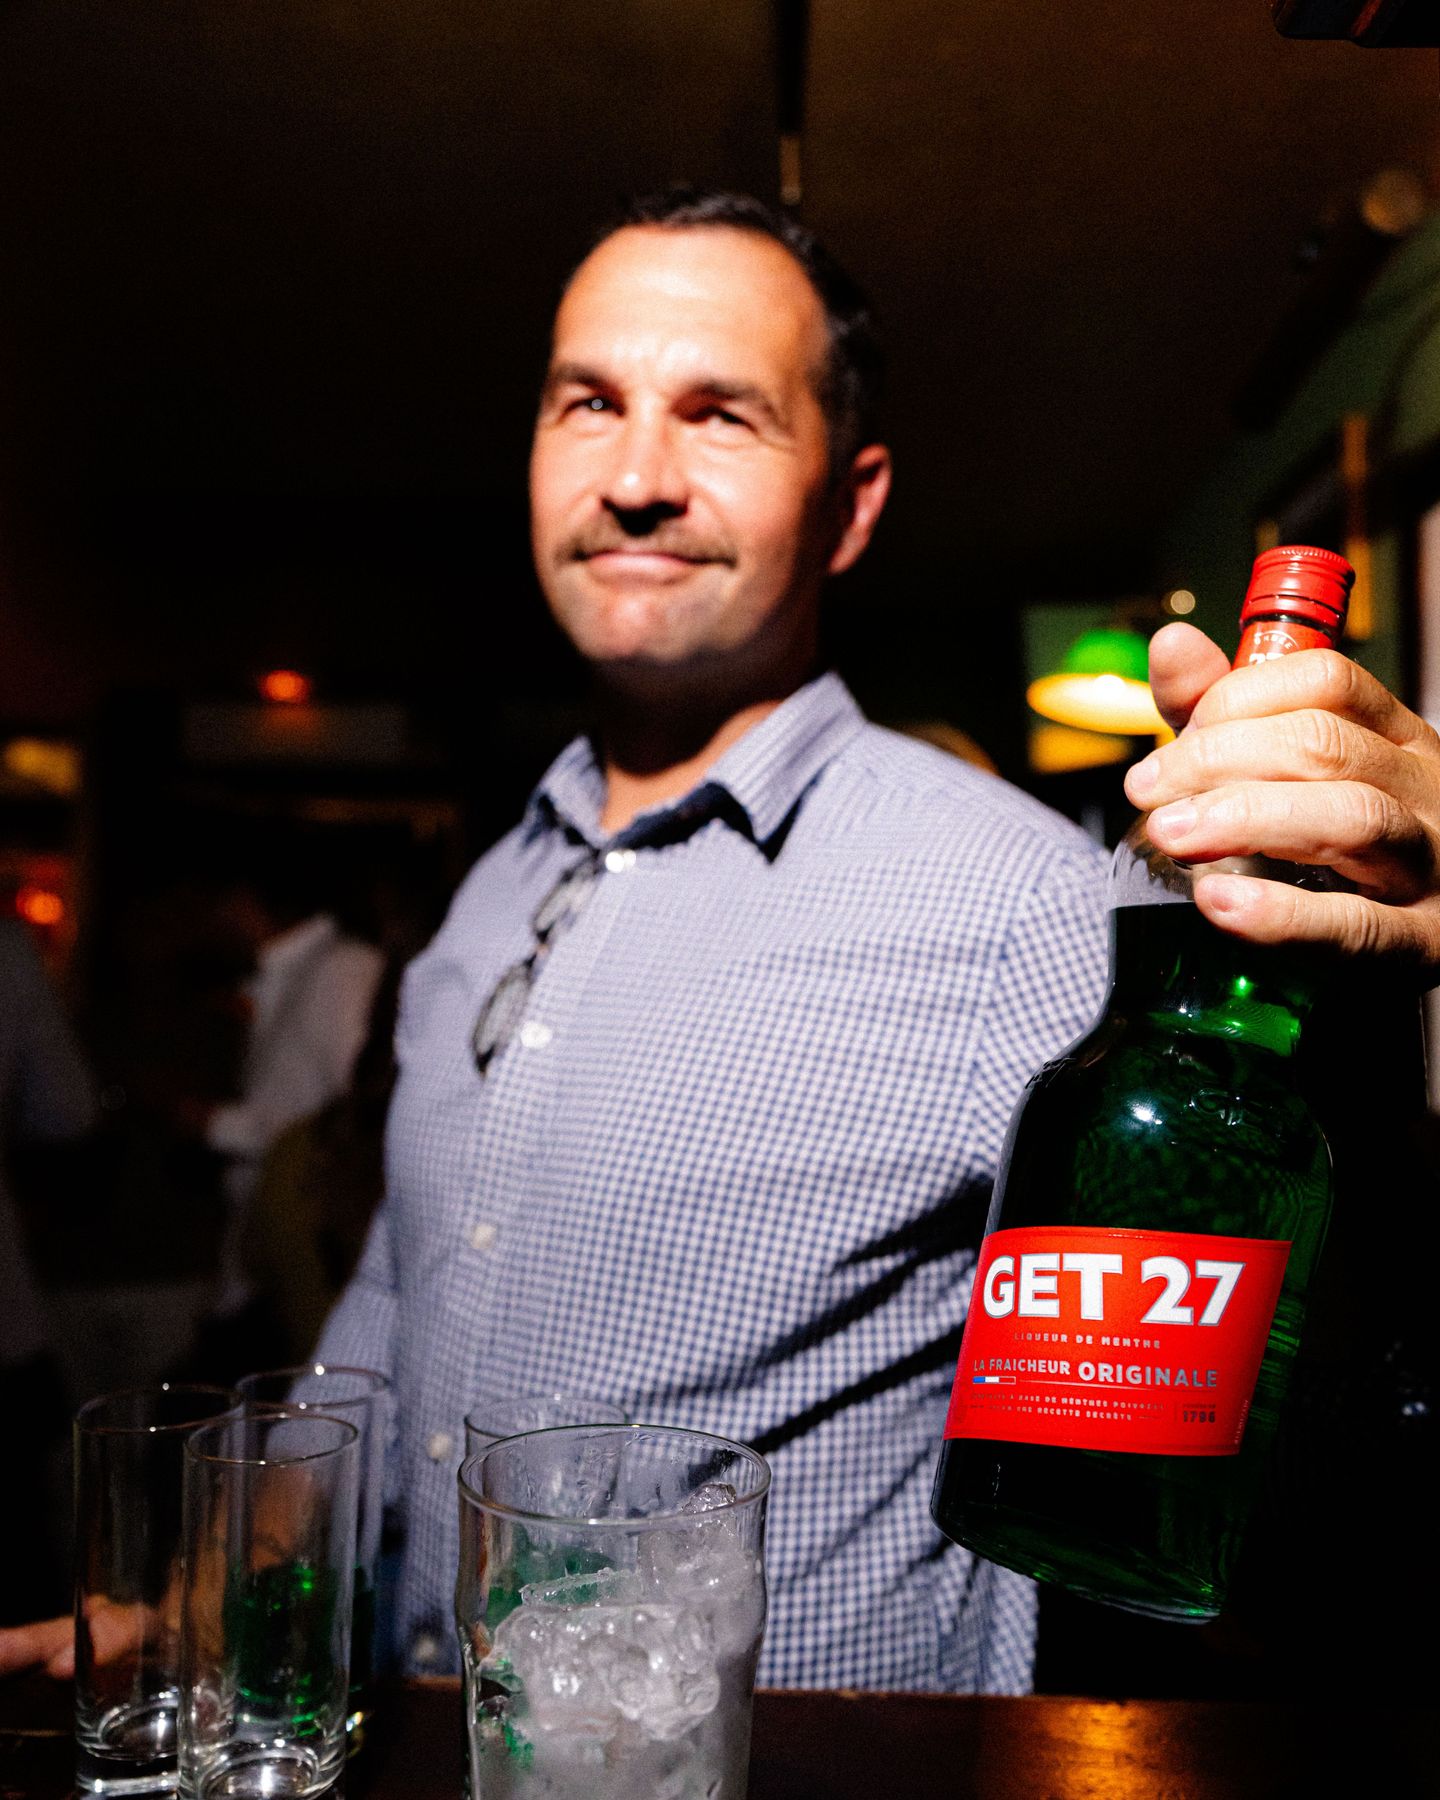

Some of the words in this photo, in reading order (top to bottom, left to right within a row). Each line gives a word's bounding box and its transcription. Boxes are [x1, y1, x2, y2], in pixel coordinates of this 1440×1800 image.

[983, 1253, 1123, 1321] GET
[1140, 1255, 1246, 1326] 27
[1014, 1332, 1068, 1343] LIQUEUR
[1075, 1334, 1093, 1345] DE
[1101, 1336, 1160, 1349] MENTHE
[973, 1359, 985, 1372] LA
[989, 1359, 1070, 1375] FRAICHEUR
[1078, 1361, 1217, 1387] ORIGINALE
